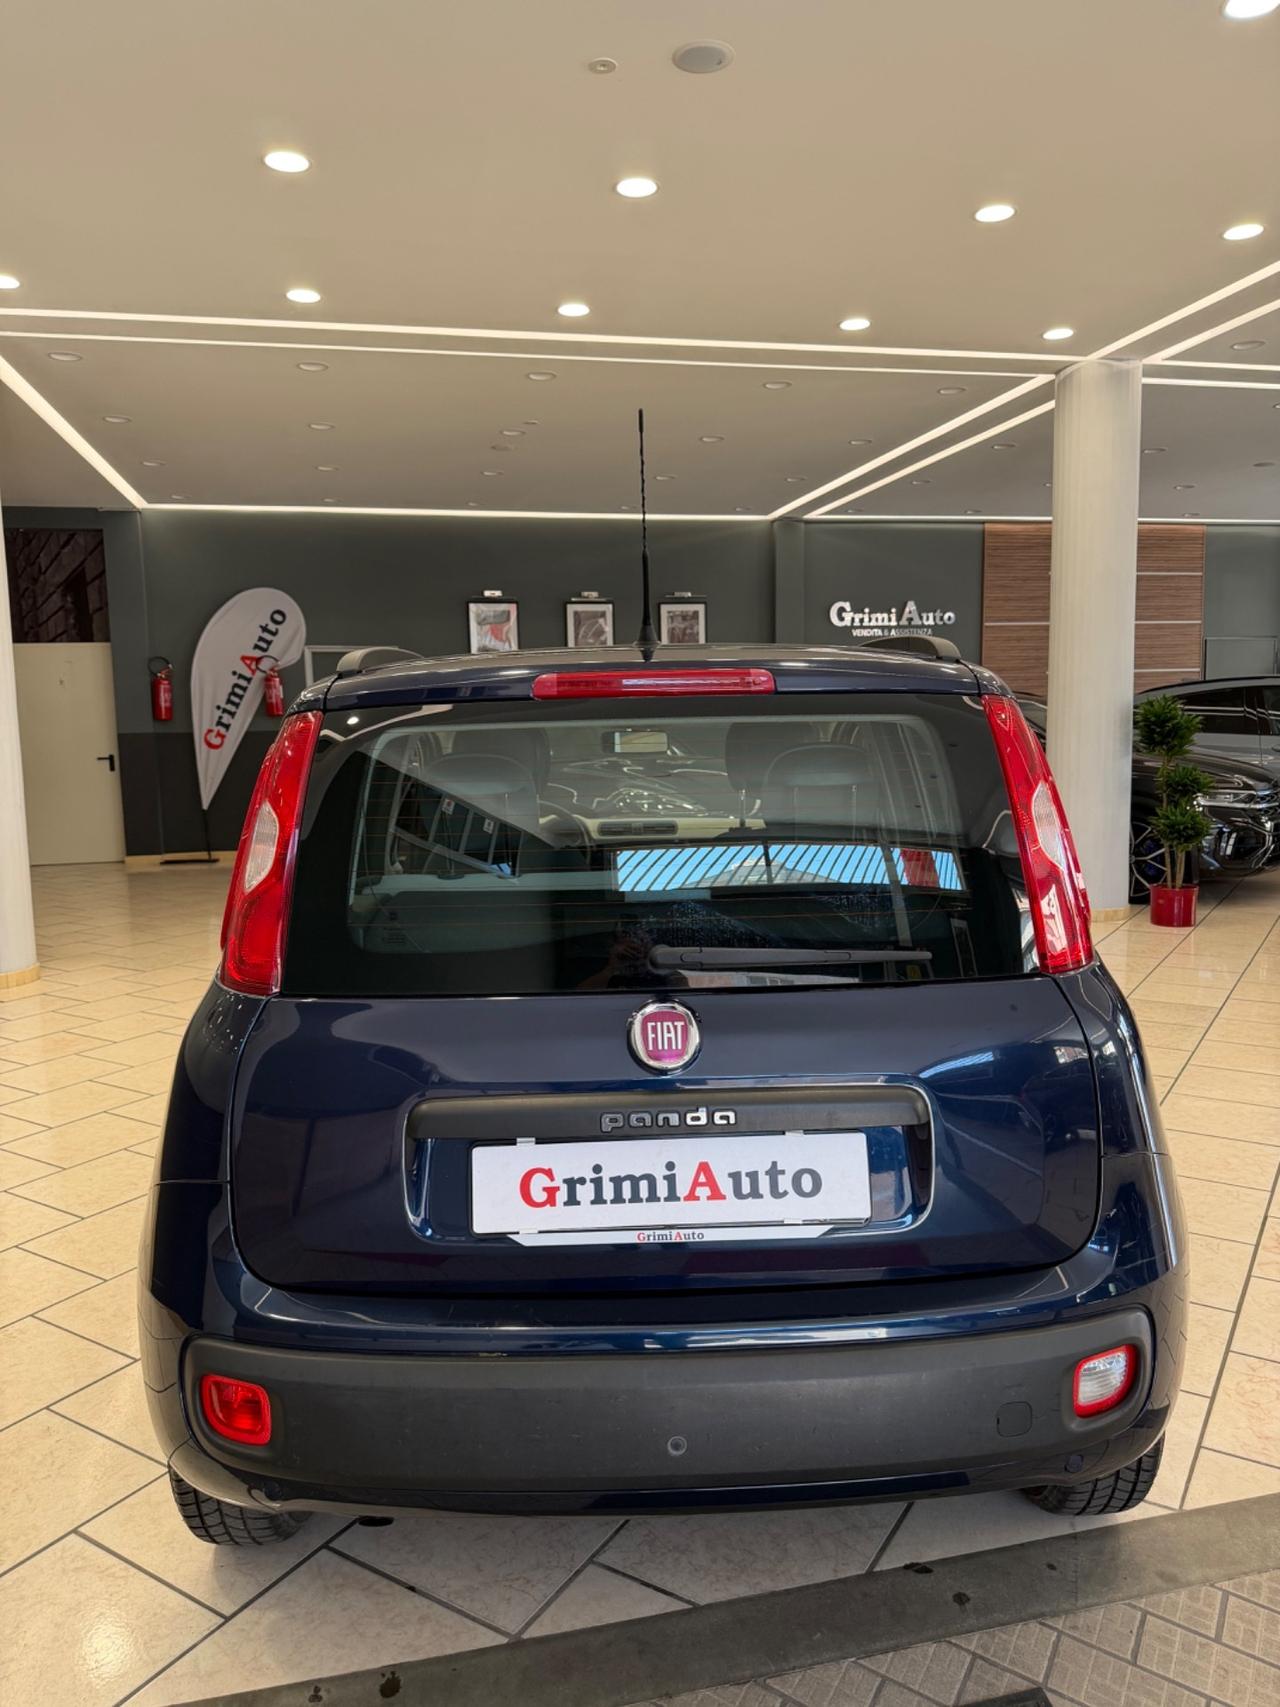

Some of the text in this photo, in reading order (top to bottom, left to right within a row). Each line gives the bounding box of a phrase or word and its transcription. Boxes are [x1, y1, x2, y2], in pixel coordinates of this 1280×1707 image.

[851, 628, 883, 637] VENDITA
[890, 628, 933, 637] ASSISTENZA
[204, 609, 287, 750] GrimiAuto
[647, 1021, 685, 1051] FIAT
[601, 1107, 737, 1133] panda
[519, 1160, 823, 1209] GrimiAuto
[637, 1231, 705, 1242] GrimiAuto
